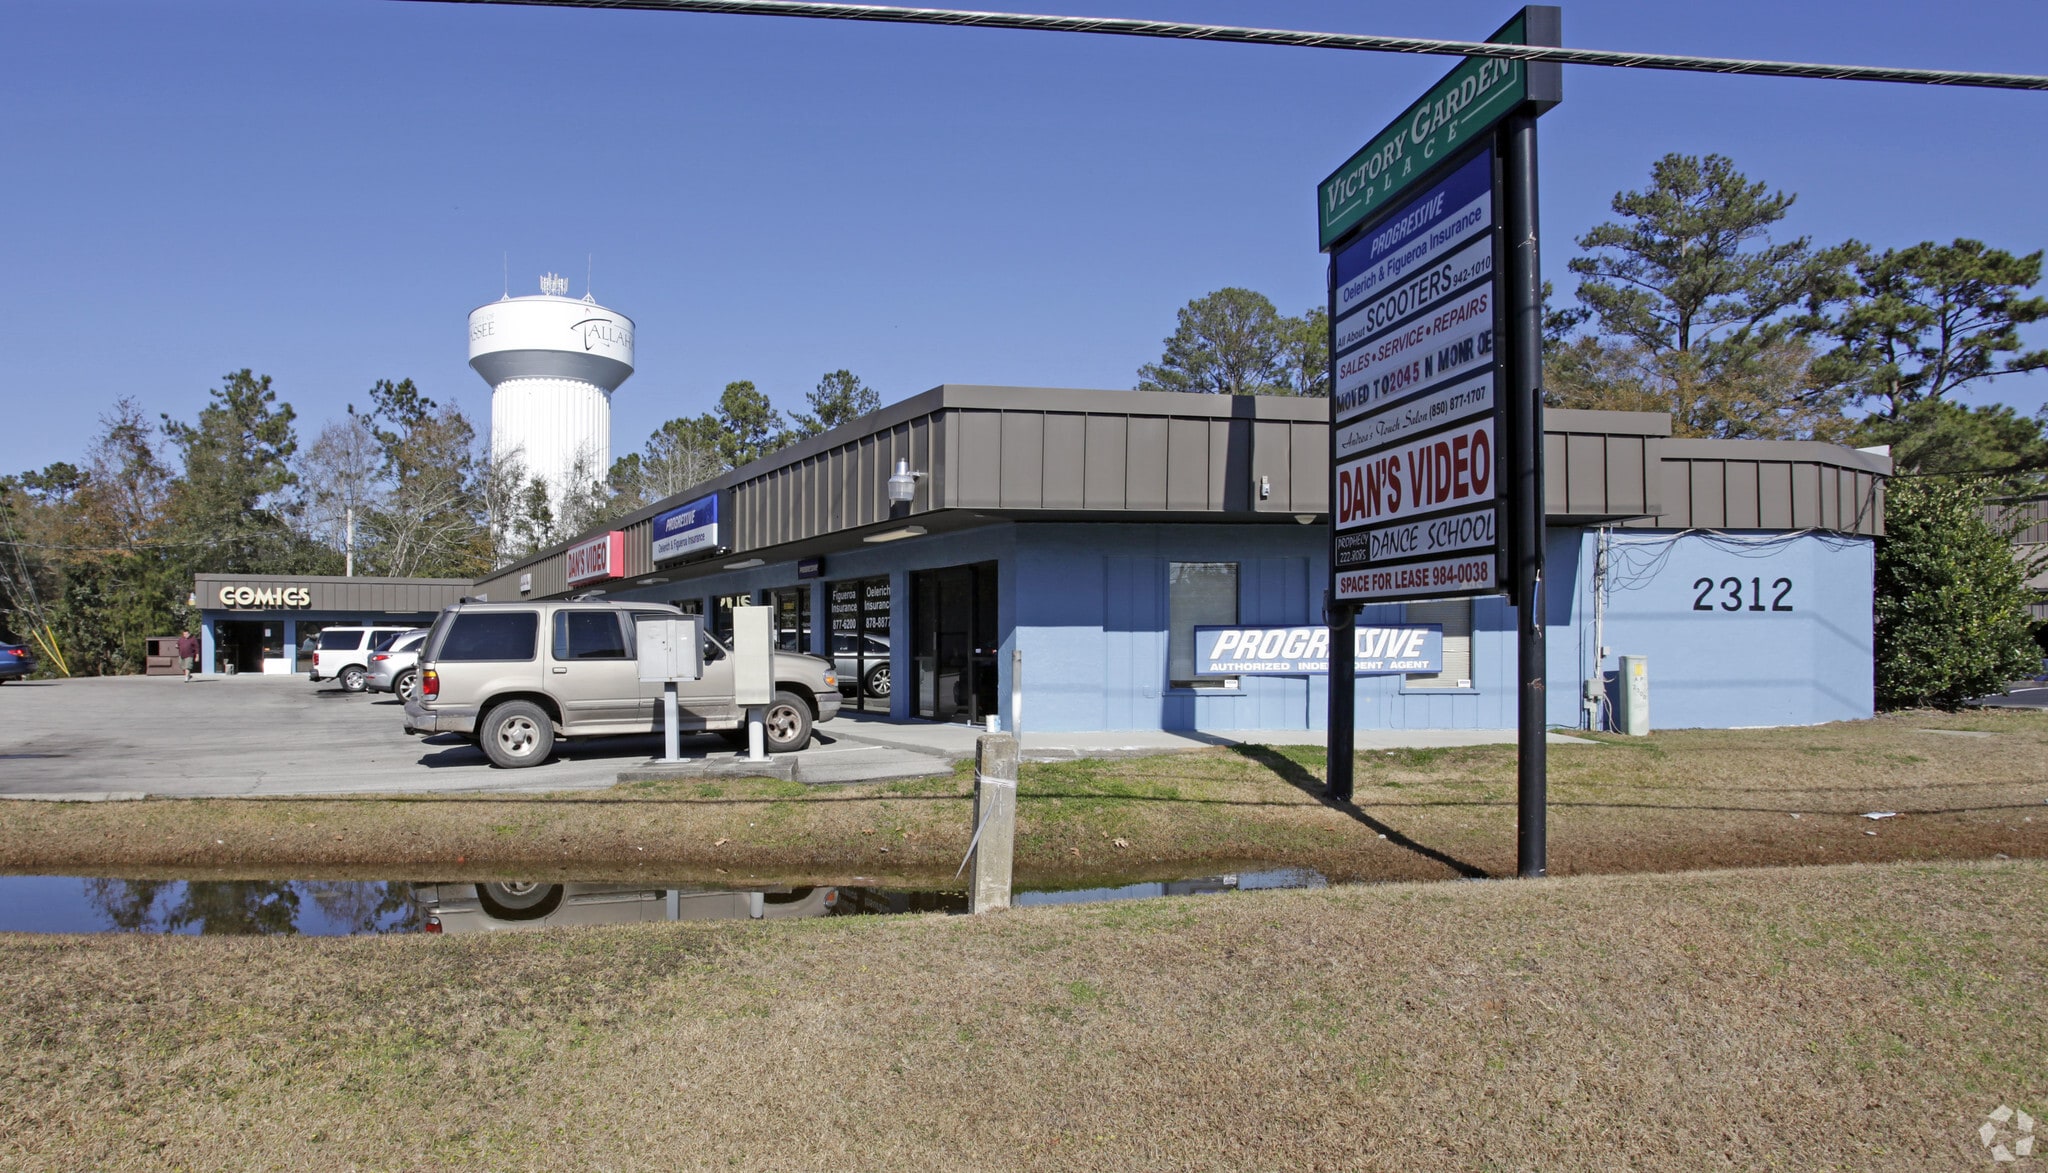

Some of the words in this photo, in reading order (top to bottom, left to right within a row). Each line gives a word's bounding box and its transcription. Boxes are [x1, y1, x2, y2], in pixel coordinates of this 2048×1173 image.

[1327, 128, 1408, 213] VICTORY
[1411, 43, 1513, 145] GARDEN
[1370, 191, 1445, 260] PROGRESSIVE
[1343, 273, 1377, 303] Oelerich
[1378, 266, 1385, 282] &
[1387, 242, 1428, 275] Figueroa
[1429, 207, 1482, 250] Insurance
[1337, 335, 1346, 348] All
[1347, 327, 1365, 346] About
[1366, 264, 1452, 333] SCOOTERS
[1453, 255, 1491, 287] 942-1010
[1339, 352, 1370, 380] SALES
[1377, 325, 1424, 362] SERVICE
[1433, 294, 1488, 336] REPAIRS
[1336, 384, 1370, 414] MOVED
[1424, 355, 1433, 378] N
[1375, 418, 1400, 436] Touch
[1402, 410, 1428, 429] Salon
[1429, 401, 1448, 421] (850)
[1449, 386, 1486, 410] 877-1707
[1339, 455, 1402, 524] DAN'S
[1407, 429, 1491, 508] VIDEO
[665, 509, 696, 532] PROGRESSIVE
[1372, 525, 1419, 559] DANCE
[1427, 513, 1494, 550] SCHOOL
[586, 541, 607, 573] VIDEO
[1340, 575, 1369, 594] SPACE
[1372, 572, 1392, 590] FOR
[1394, 568, 1429, 589] LEASE
[1432, 561, 1488, 586] 984-0038
[1692, 576, 1793, 612] 2312
[219, 586, 310, 606] COMICS
[831, 603, 858, 613] Insurance
[832, 590, 856, 603] Figueroa
[864, 600, 890, 611] Insuranc
[1209, 627, 1429, 660] PROGRSSIVE
[1209, 661, 1290, 671] AUTHORIZED
[1298, 661, 1383, 671] INDEDENT
[1390, 660, 1430, 670] AGENT
